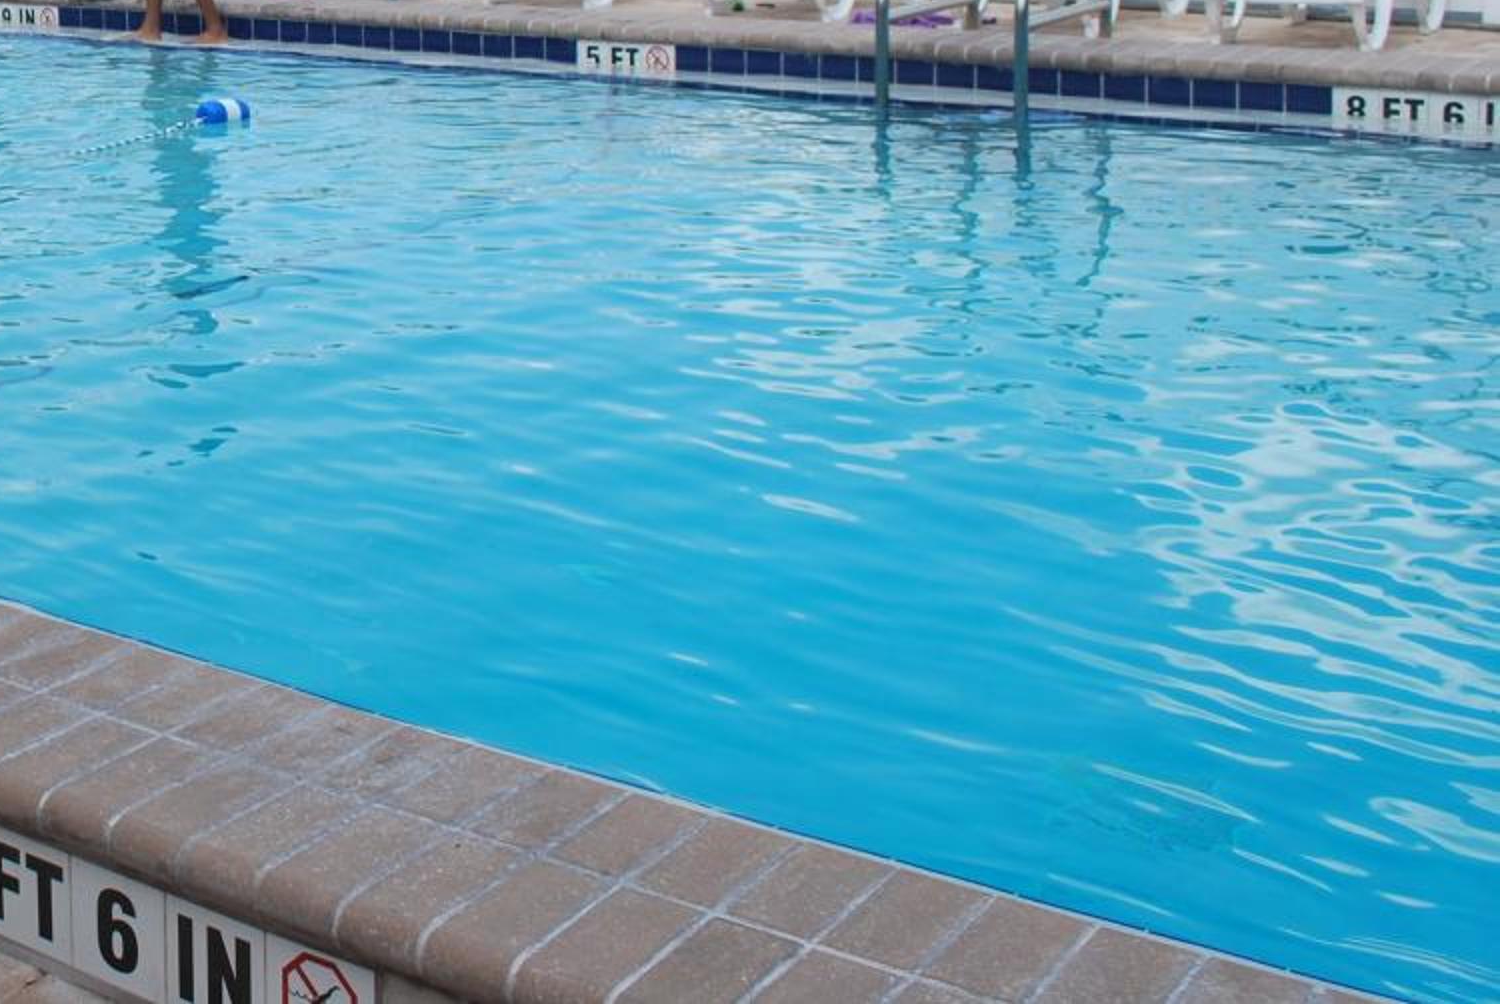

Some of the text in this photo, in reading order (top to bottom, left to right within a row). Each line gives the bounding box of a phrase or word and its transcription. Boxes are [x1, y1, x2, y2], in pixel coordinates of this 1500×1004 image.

[19, 8, 35, 25] IN
[587, 46, 639, 66] 5 FT
[1347, 95, 1365, 117] 8
[1382, 97, 1425, 122] FT
[1443, 102, 1465, 124] 6
[96, 888, 139, 975] 6
[177, 913, 252, 1004] IN
